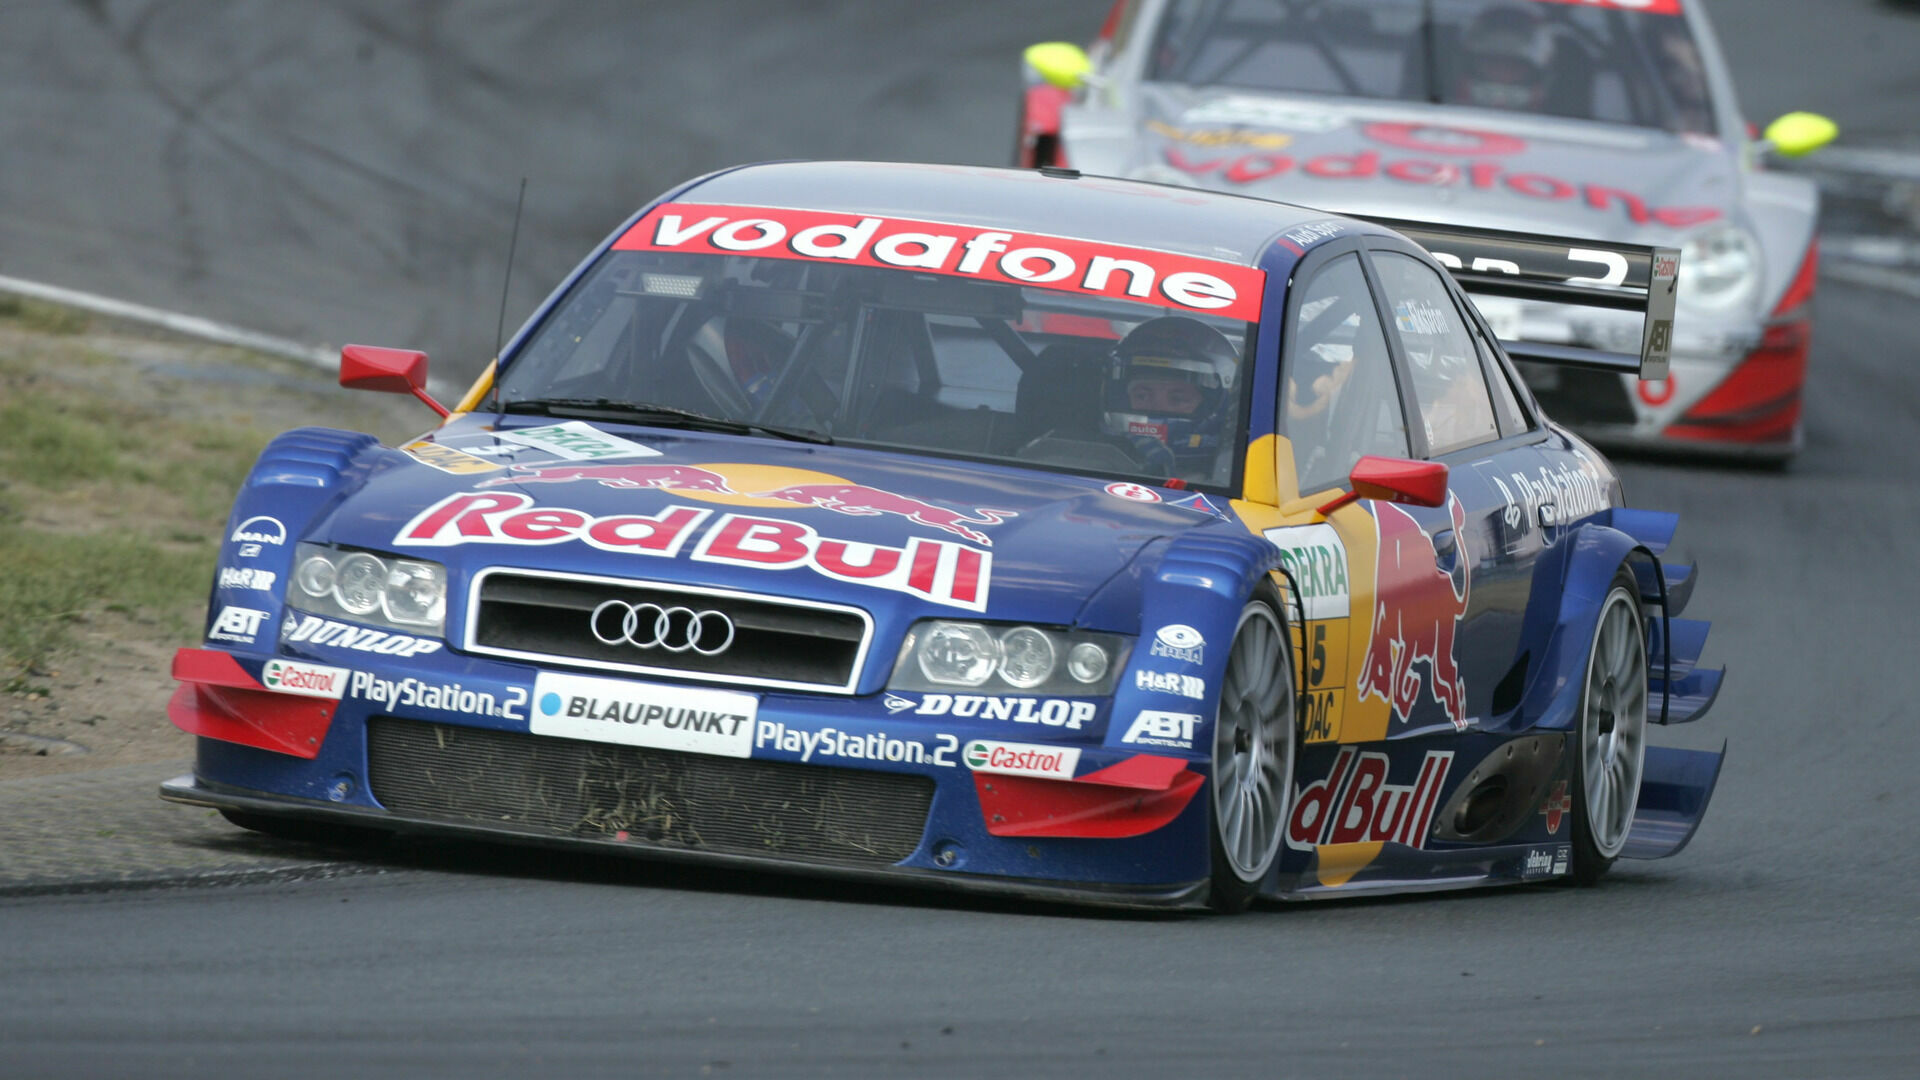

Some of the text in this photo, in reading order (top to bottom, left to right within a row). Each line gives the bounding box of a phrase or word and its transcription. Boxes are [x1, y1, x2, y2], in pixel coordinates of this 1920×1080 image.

[1164, 148, 1722, 228] vodafone
[654, 215, 1238, 310] vodafone
[1644, 319, 1673, 362] ABT
[513, 427, 631, 458] DEKRA
[393, 491, 992, 613] Red Bull
[1281, 543, 1348, 598] DEKRA
[208, 604, 264, 640] ABT
[289, 614, 443, 657] DUNLOP
[281, 665, 336, 692] Castrol
[351, 670, 496, 716] PlayStation
[1135, 669, 1181, 696] H&R
[566, 696, 748, 737] BLAUPUNKT
[915, 693, 1097, 730] DUNLOP
[1121, 709, 1196, 744] ABT
[1298, 691, 1334, 740] DAC
[756, 720, 925, 765] PlayStation
[989, 746, 1063, 772] Castrol
[1325, 750, 1455, 851] Bull
